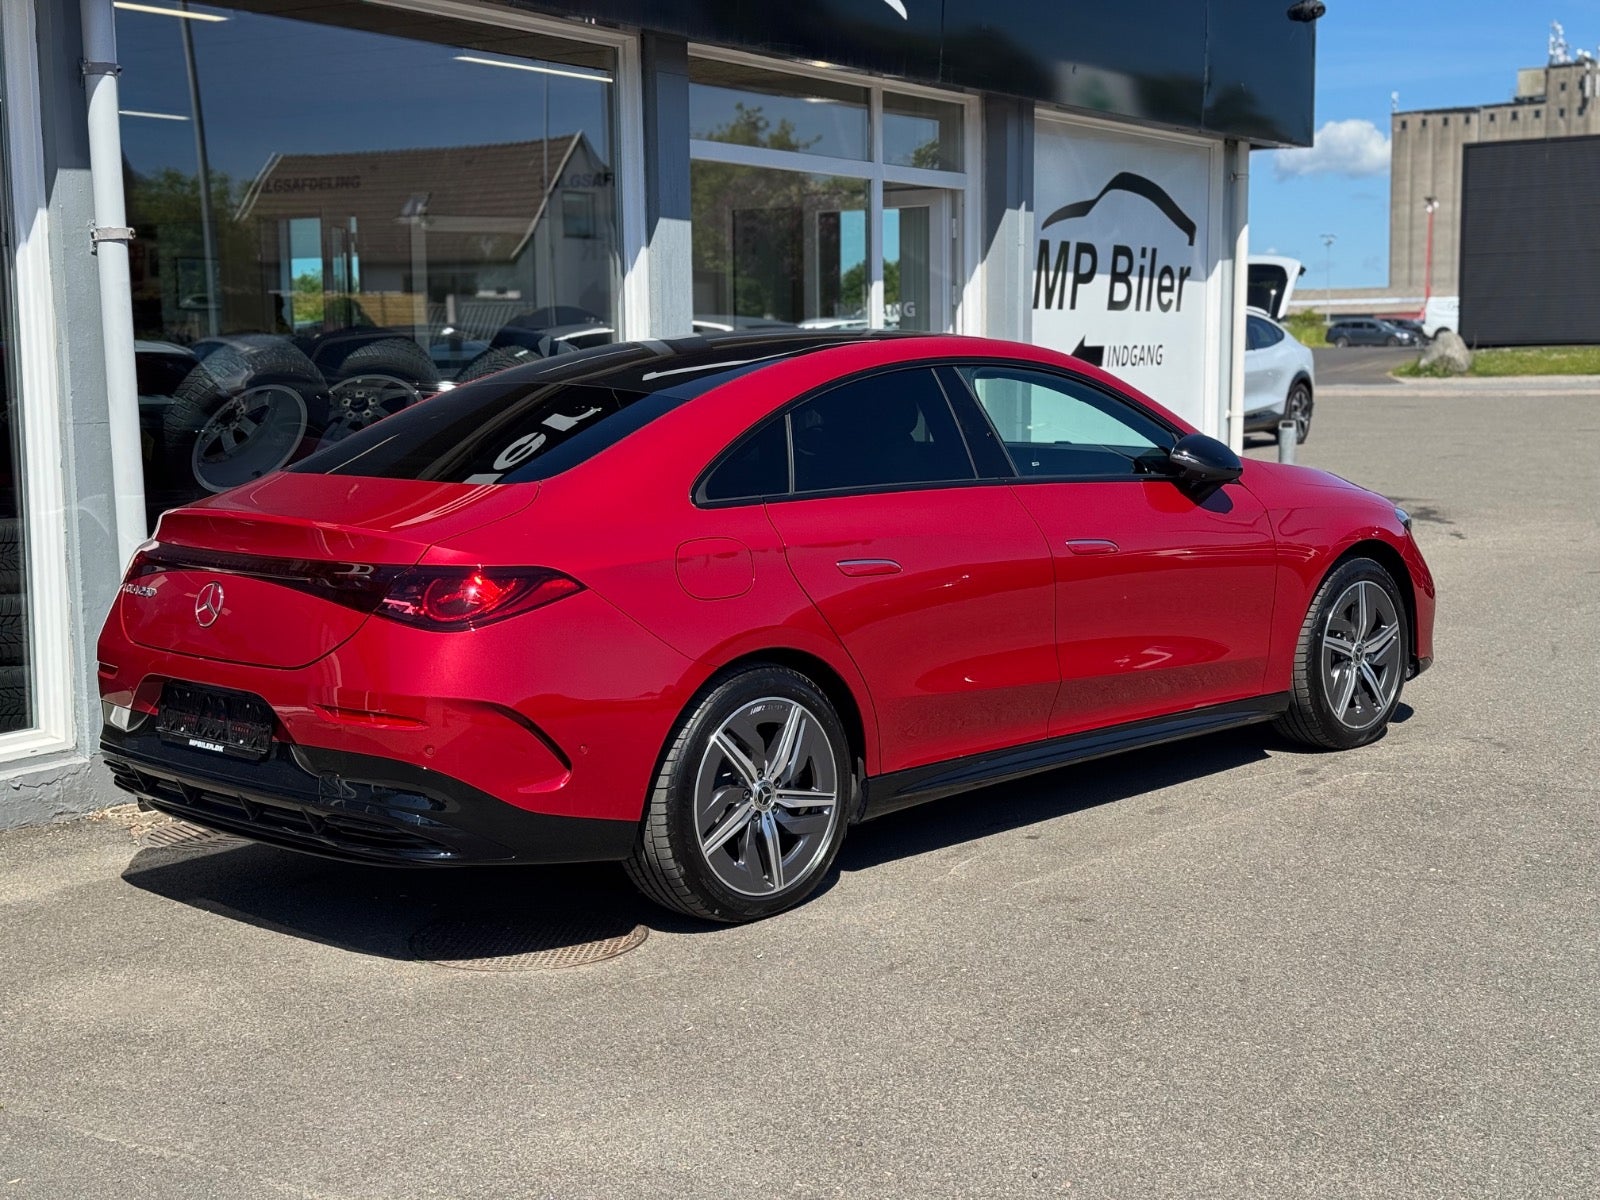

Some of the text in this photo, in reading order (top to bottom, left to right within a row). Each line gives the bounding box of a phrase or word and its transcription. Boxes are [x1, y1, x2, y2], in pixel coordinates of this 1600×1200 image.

[1033, 239, 1192, 313] MP Biler
[1107, 344, 1163, 368] INDGANG
